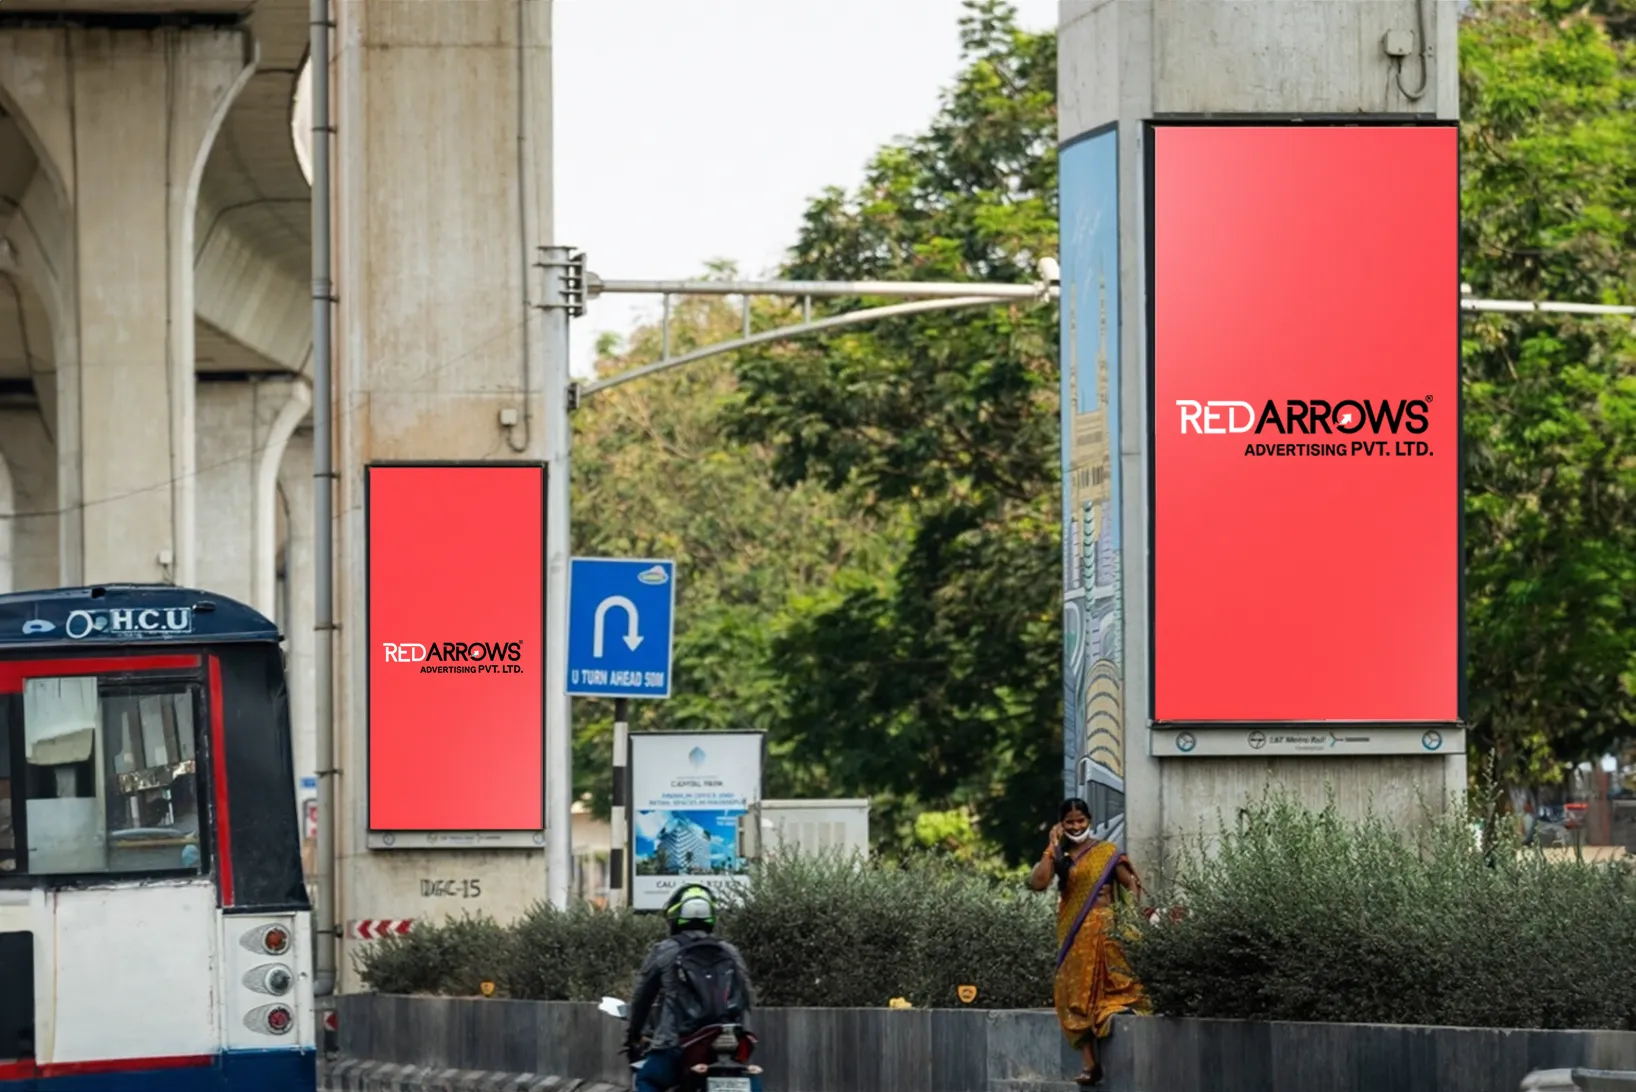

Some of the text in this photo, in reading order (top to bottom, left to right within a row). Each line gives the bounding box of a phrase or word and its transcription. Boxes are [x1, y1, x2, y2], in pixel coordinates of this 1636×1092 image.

[1244, 441, 1433, 456] ADVERTISING PVT. LTD.
[112, 609, 188, 630] H.C.U
[478, 665, 500, 673] PVT.
[502, 665, 524, 673] LTD.
[571, 669, 579, 684] U
[581, 669, 608, 685] TURN
[609, 670, 642, 687] AHEAD
